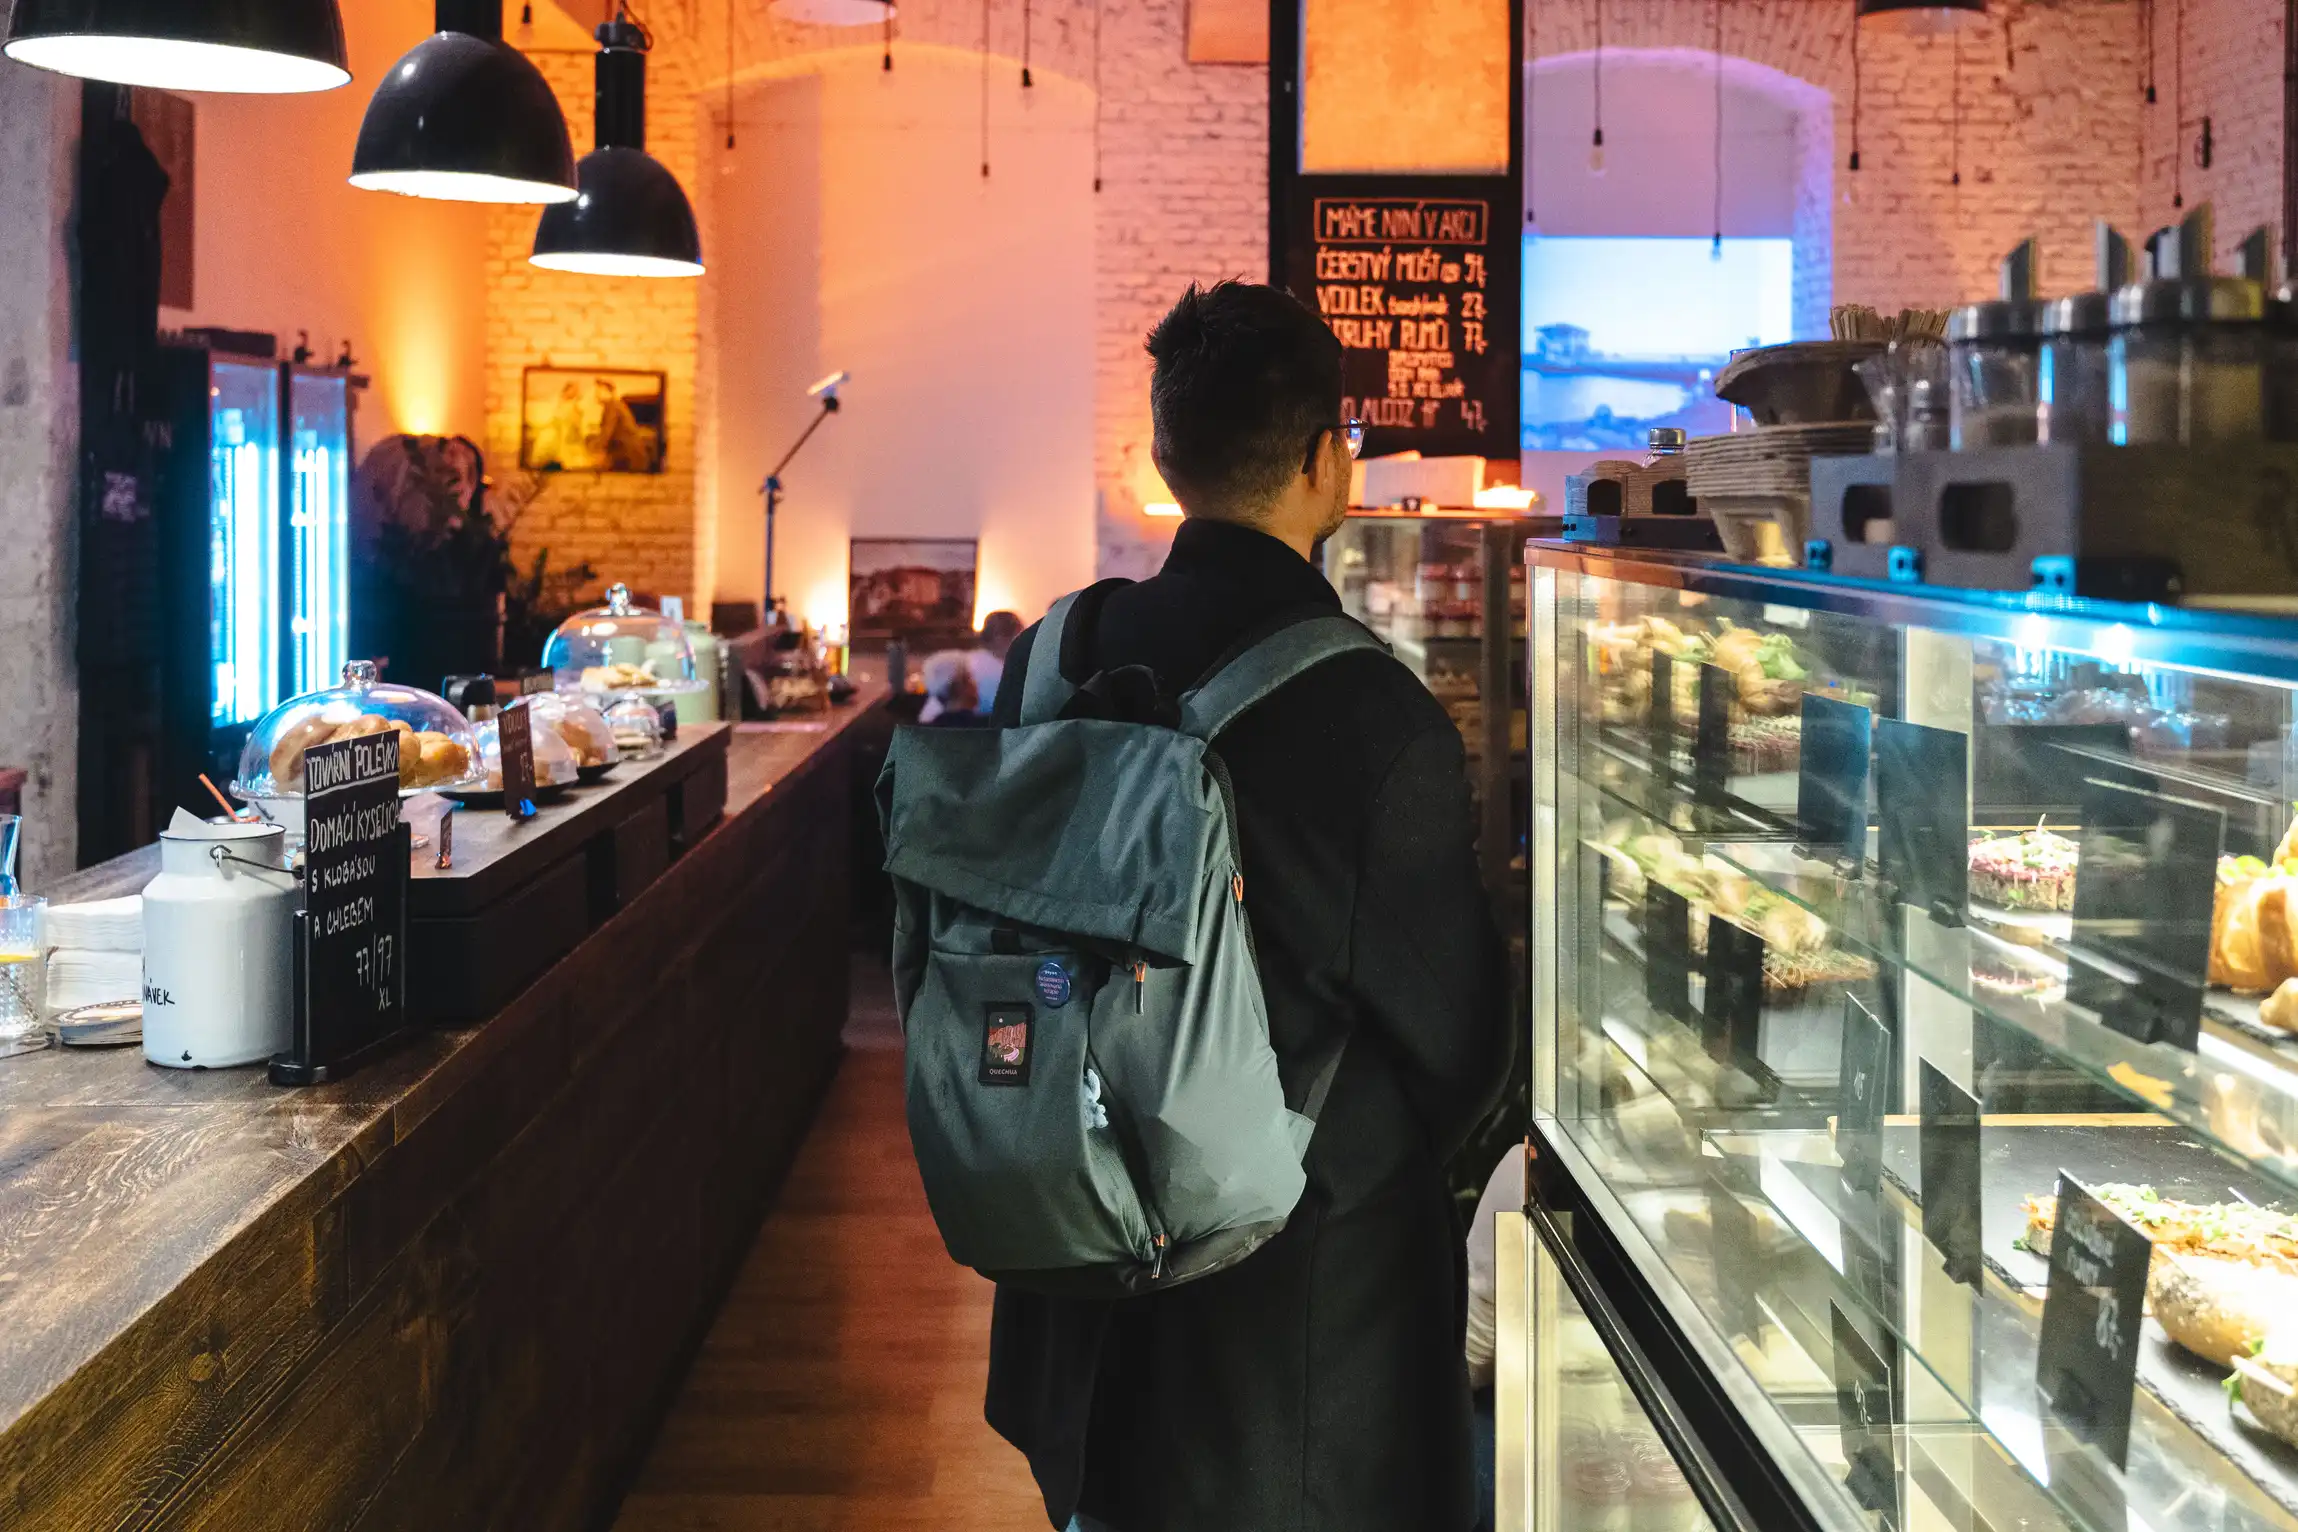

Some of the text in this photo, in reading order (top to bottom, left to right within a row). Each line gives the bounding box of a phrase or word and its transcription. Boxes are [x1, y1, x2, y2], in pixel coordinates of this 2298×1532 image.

[324, 854, 376, 889] KLOBÁSOU
[314, 896, 374, 940] A CHLEBEM
[378, 985, 392, 1011] XL
[989, 1068, 1018, 1076] QUECHUA
